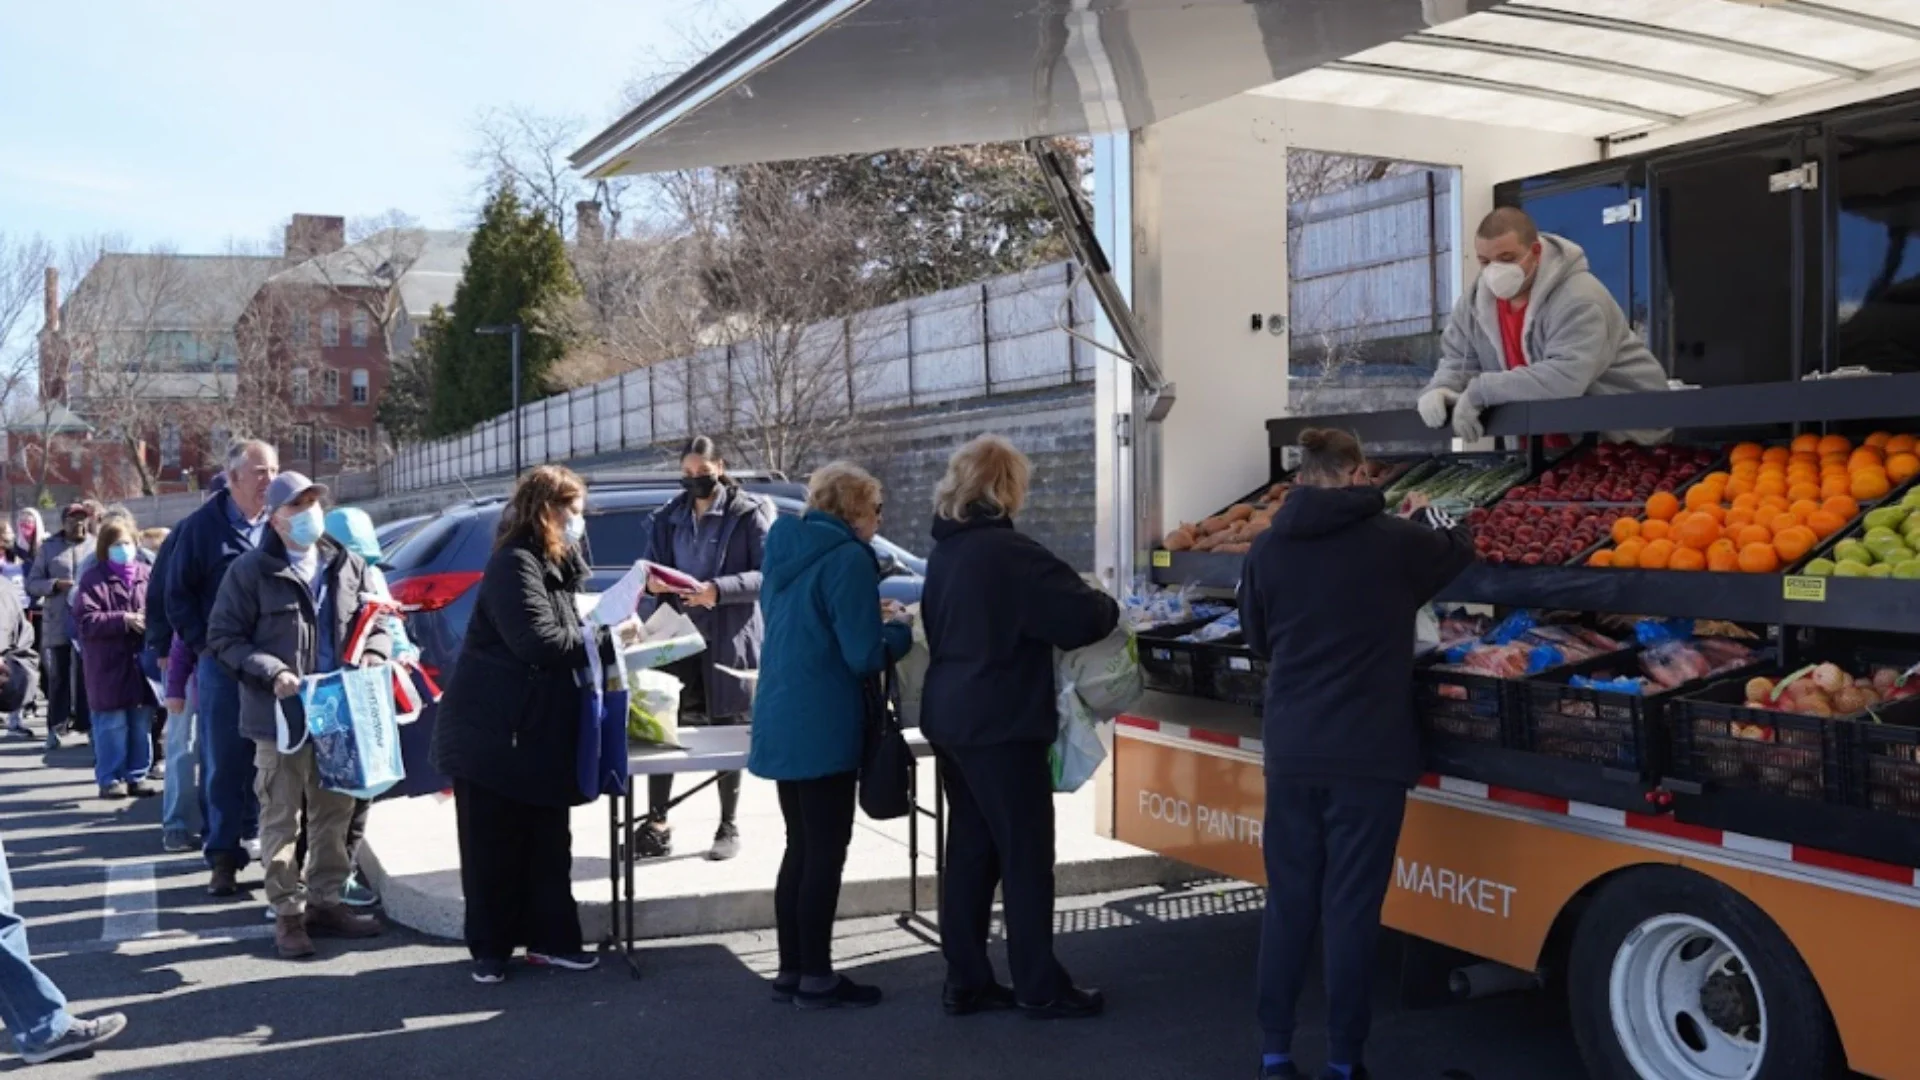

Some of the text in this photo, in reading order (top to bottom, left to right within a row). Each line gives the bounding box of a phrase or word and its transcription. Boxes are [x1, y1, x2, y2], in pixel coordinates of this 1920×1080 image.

[1138, 789, 1517, 918] FOOD PANTR MARKET
